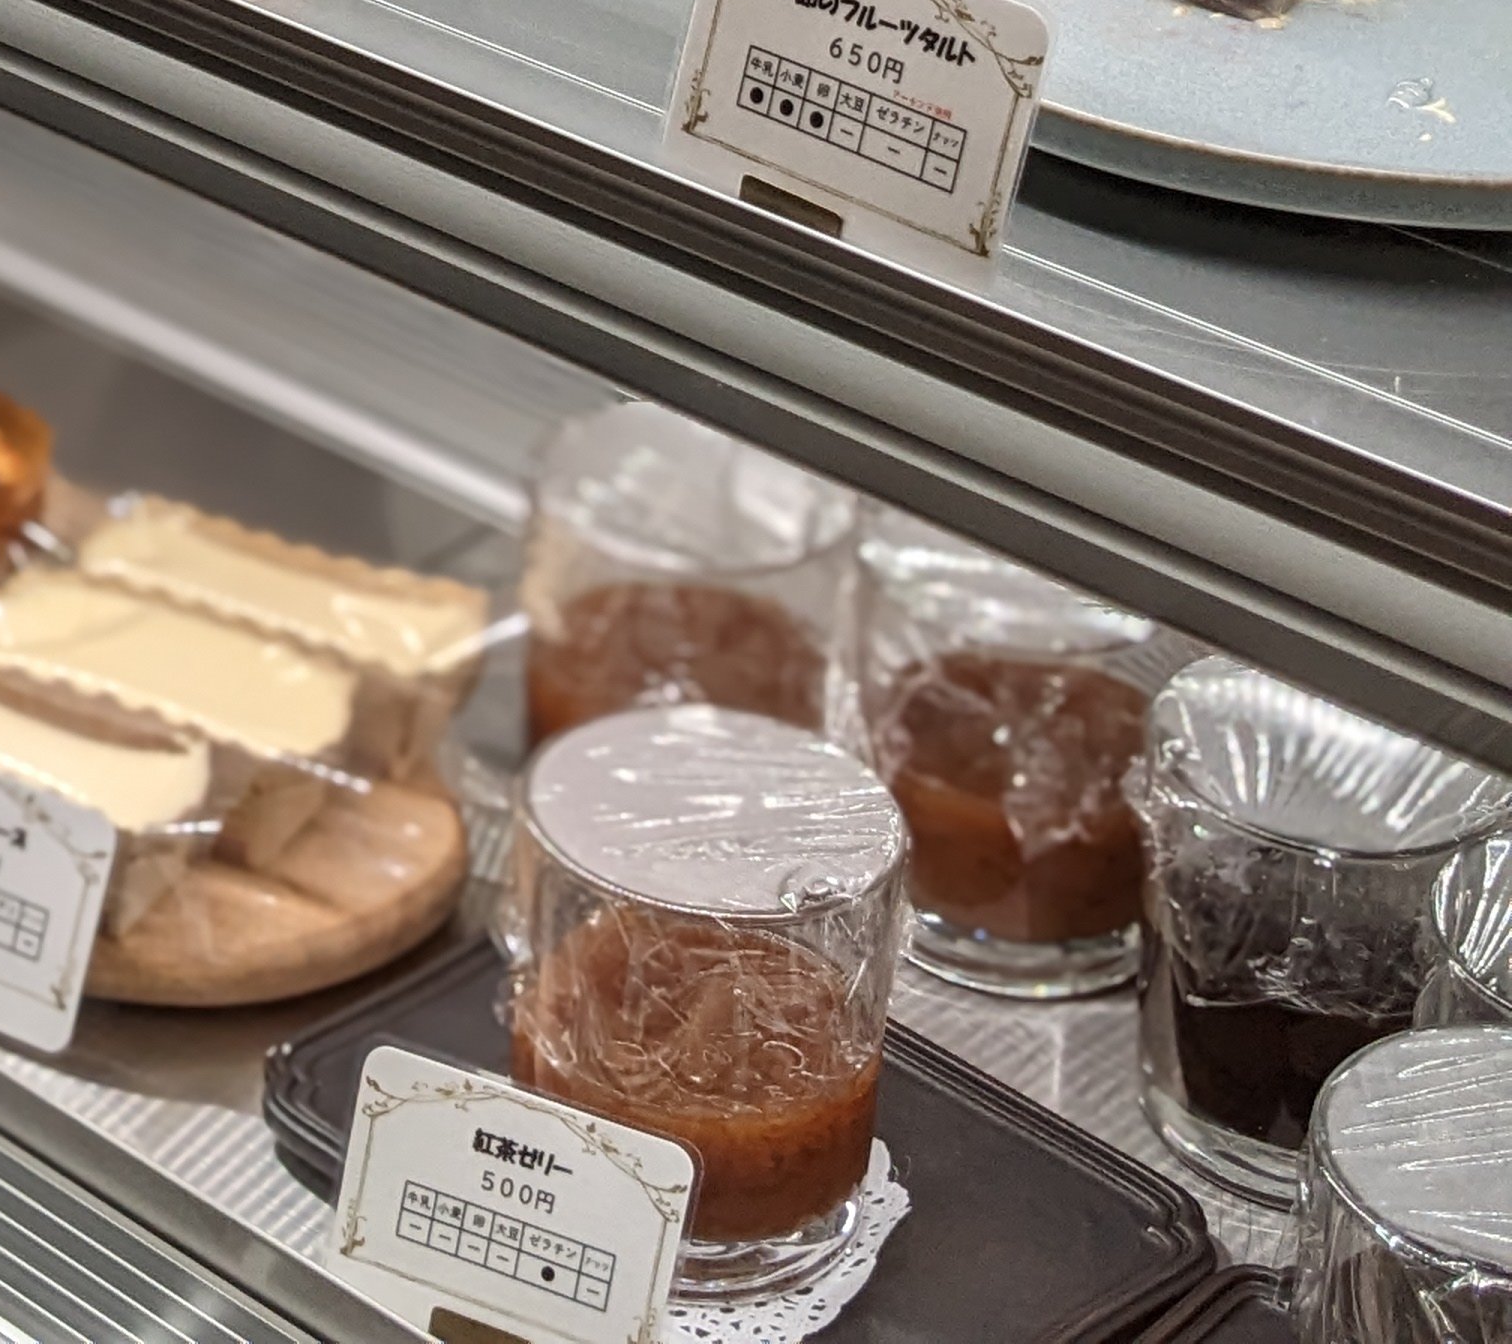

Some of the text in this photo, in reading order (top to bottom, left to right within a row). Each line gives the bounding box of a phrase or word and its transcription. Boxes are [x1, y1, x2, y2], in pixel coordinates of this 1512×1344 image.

[829, 37, 905, 84] 650円
[749, 56, 774, 78] 牛乳
[779, 68, 805, 89] 小麦
[839, 93, 865, 113] 大豆
[876, 105, 925, 133] ゼラチン
[472, 1127, 574, 1176] 紅茶ゼリー
[480, 1169, 556, 1214] 500円
[528, 1234, 577, 1259] ゼラチン
